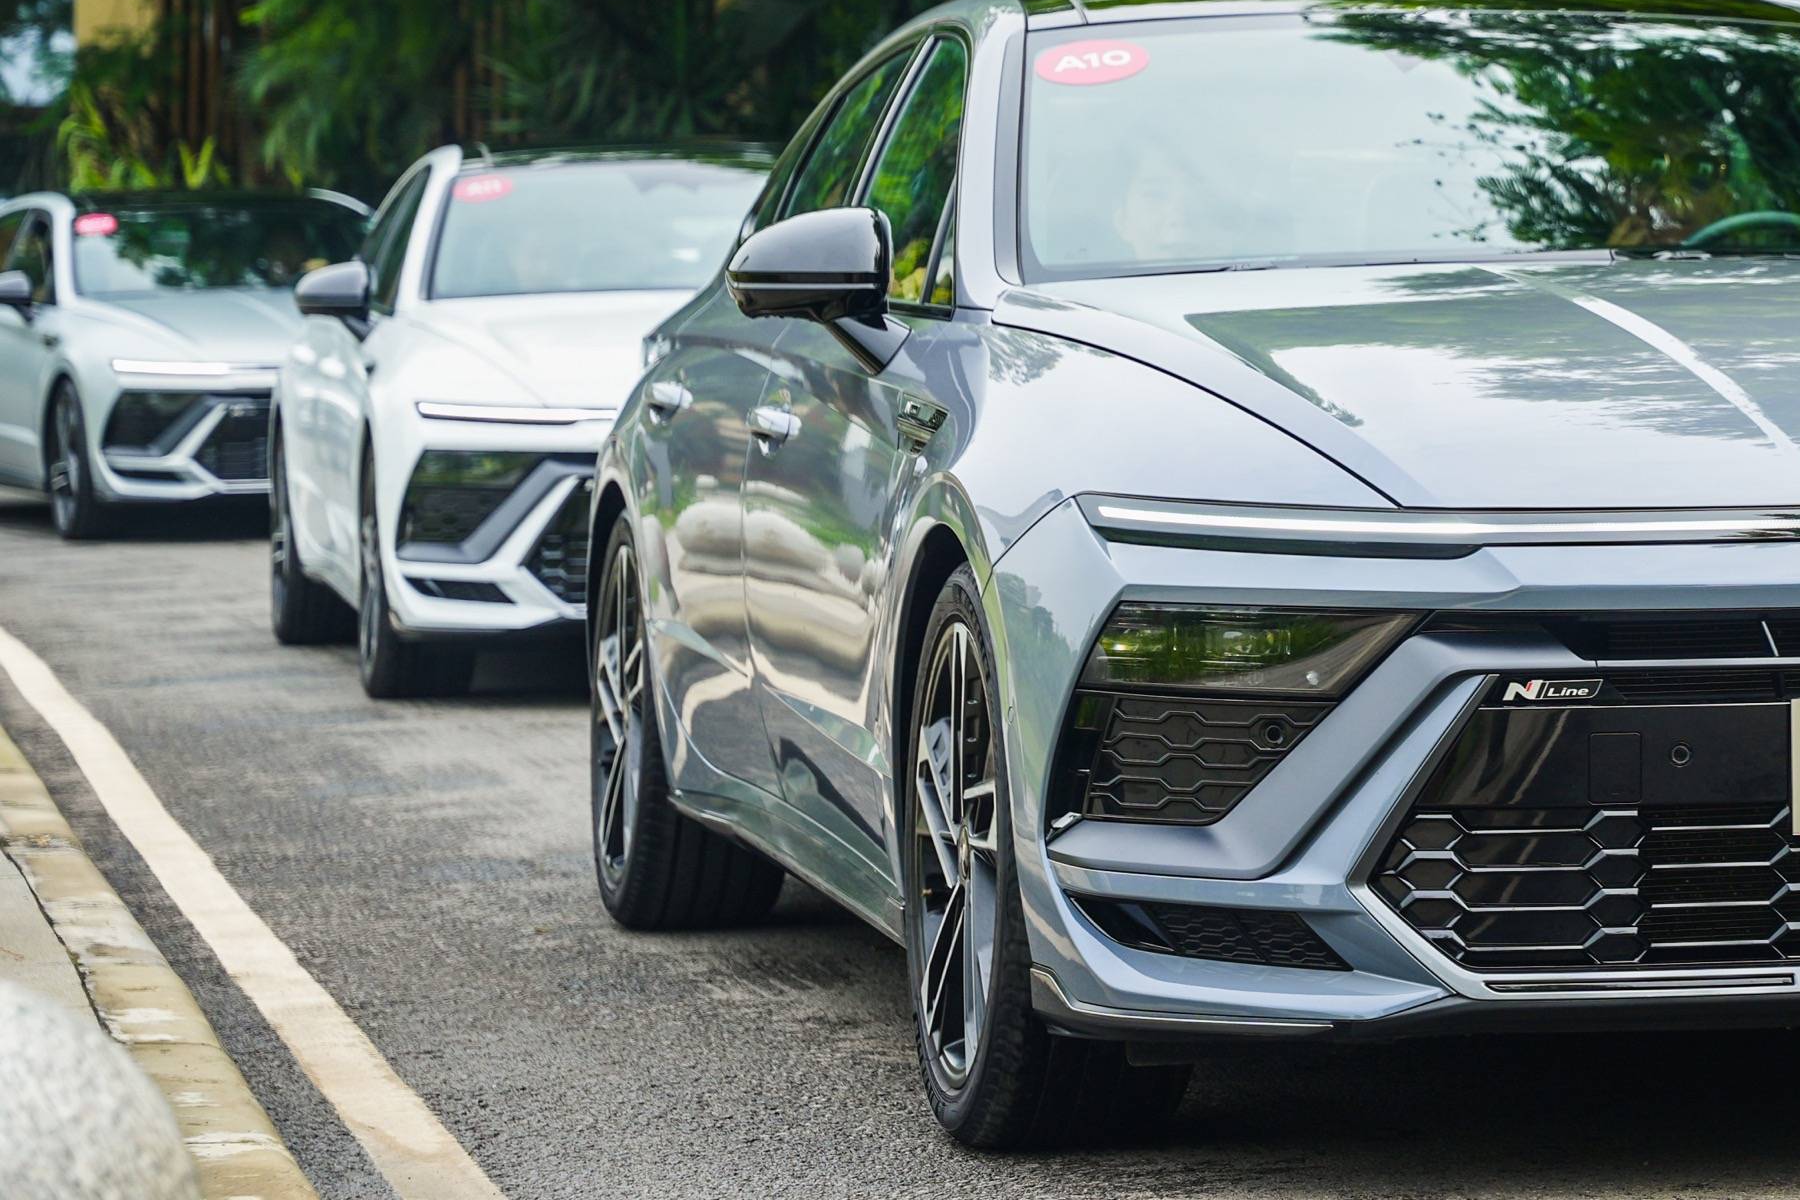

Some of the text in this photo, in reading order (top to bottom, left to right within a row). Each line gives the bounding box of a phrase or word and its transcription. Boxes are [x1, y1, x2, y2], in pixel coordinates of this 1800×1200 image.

[1054, 49, 1131, 73] A10
[1502, 680, 1589, 701] N Line
